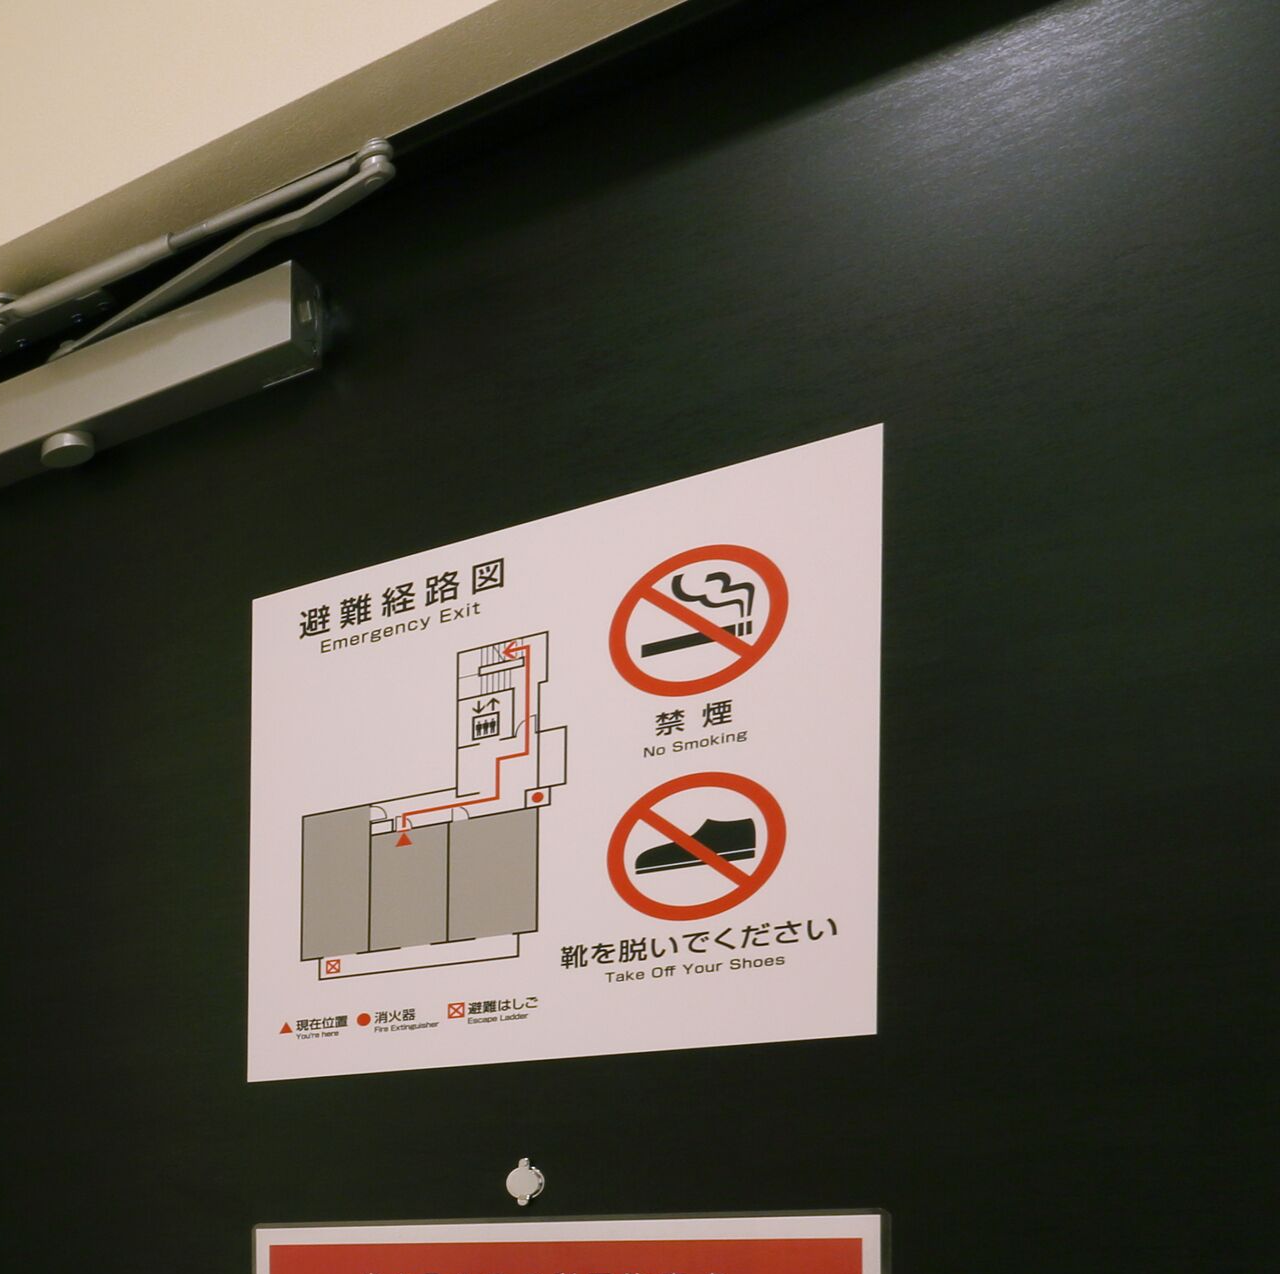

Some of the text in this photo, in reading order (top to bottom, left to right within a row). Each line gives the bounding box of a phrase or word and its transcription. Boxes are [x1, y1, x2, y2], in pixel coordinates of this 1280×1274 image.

[300, 558, 504, 639] 避難経路図
[320, 602, 480, 653] Emergency Exit
[656, 700, 732, 736] 禁煙
[644, 731, 748, 758] No Smoking
[561, 918, 837, 969] 靴を脱いでください
[605, 956, 785, 983] Take Off Your Shoes
[374, 1008, 415, 1024] 消火器
[467, 1013, 528, 1024] Escape Ladder
[468, 997, 538, 1015] 避難はしご
[296, 1015, 348, 1031] 現在位置
[390, 1022, 440, 1031] Extinguisher
